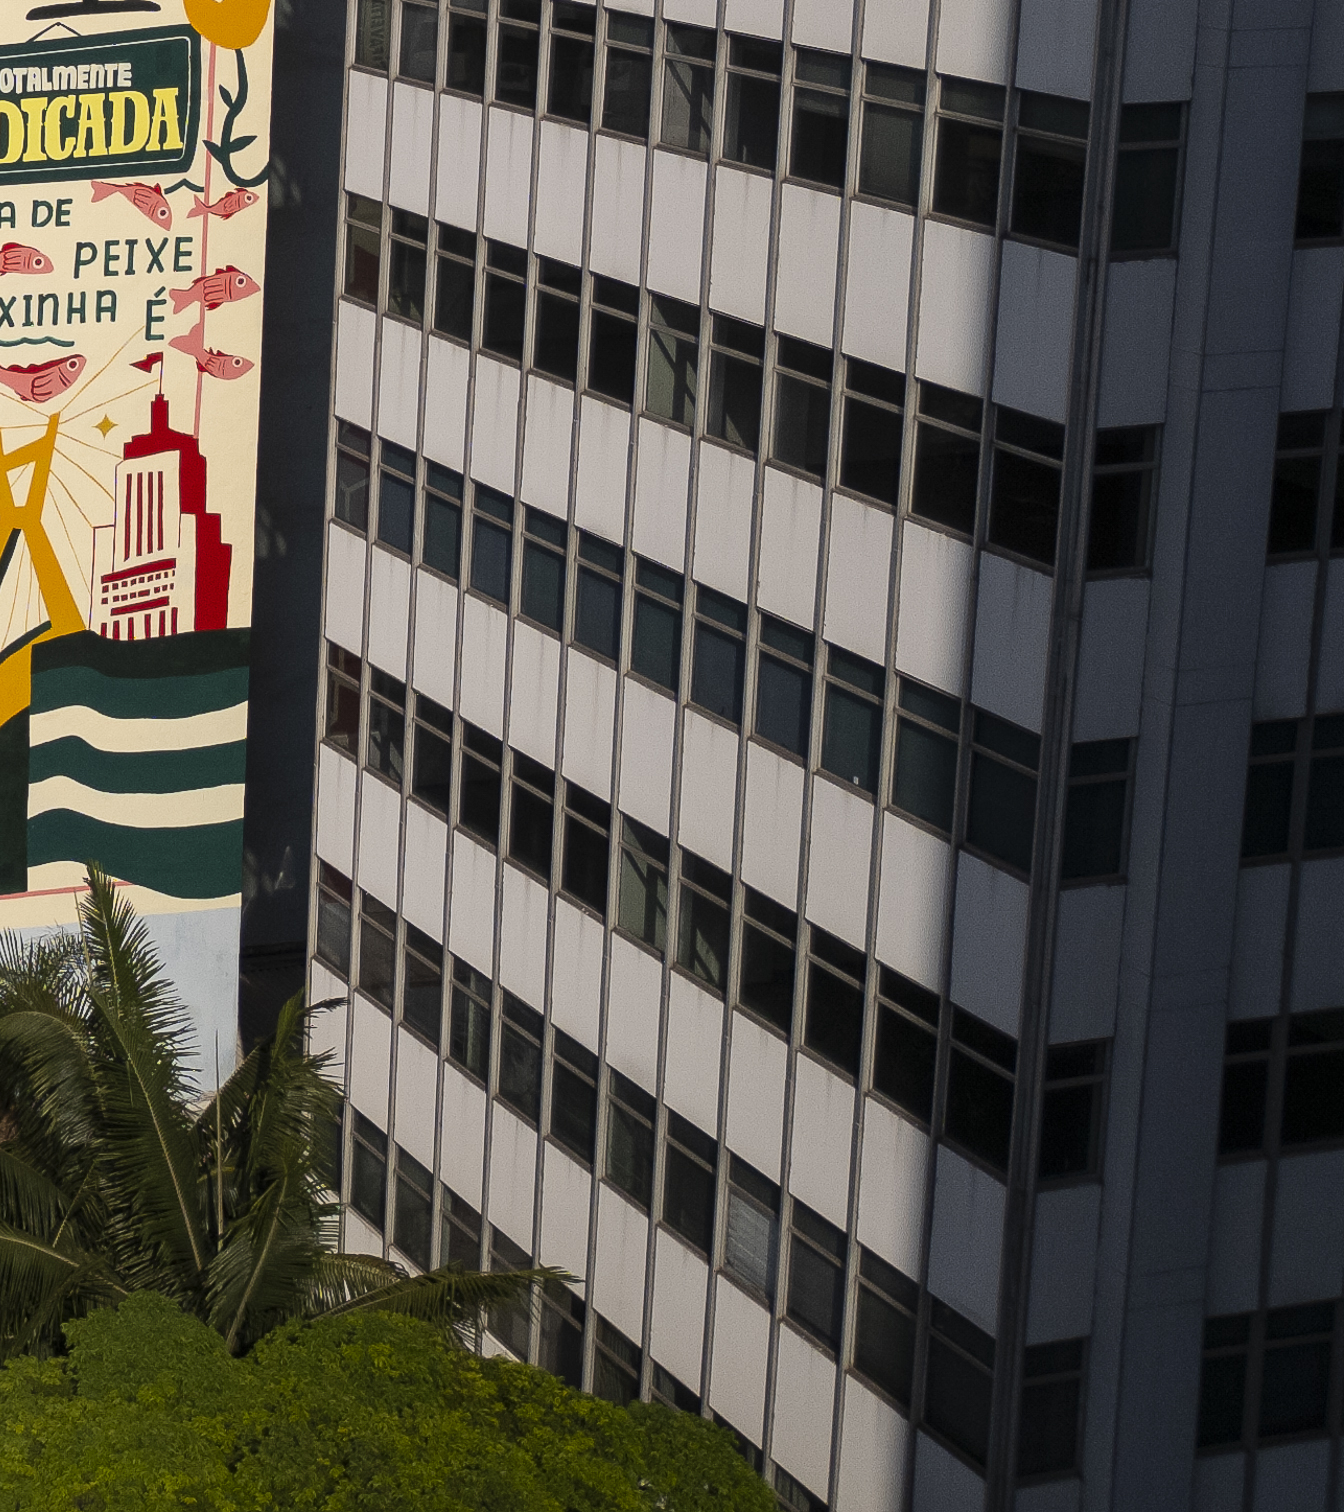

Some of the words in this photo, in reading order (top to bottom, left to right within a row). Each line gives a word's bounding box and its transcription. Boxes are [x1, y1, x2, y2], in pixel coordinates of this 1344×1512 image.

[31, 198, 73, 228] DE
[74, 237, 193, 279] PEIXE
[145, 287, 167, 341] É
